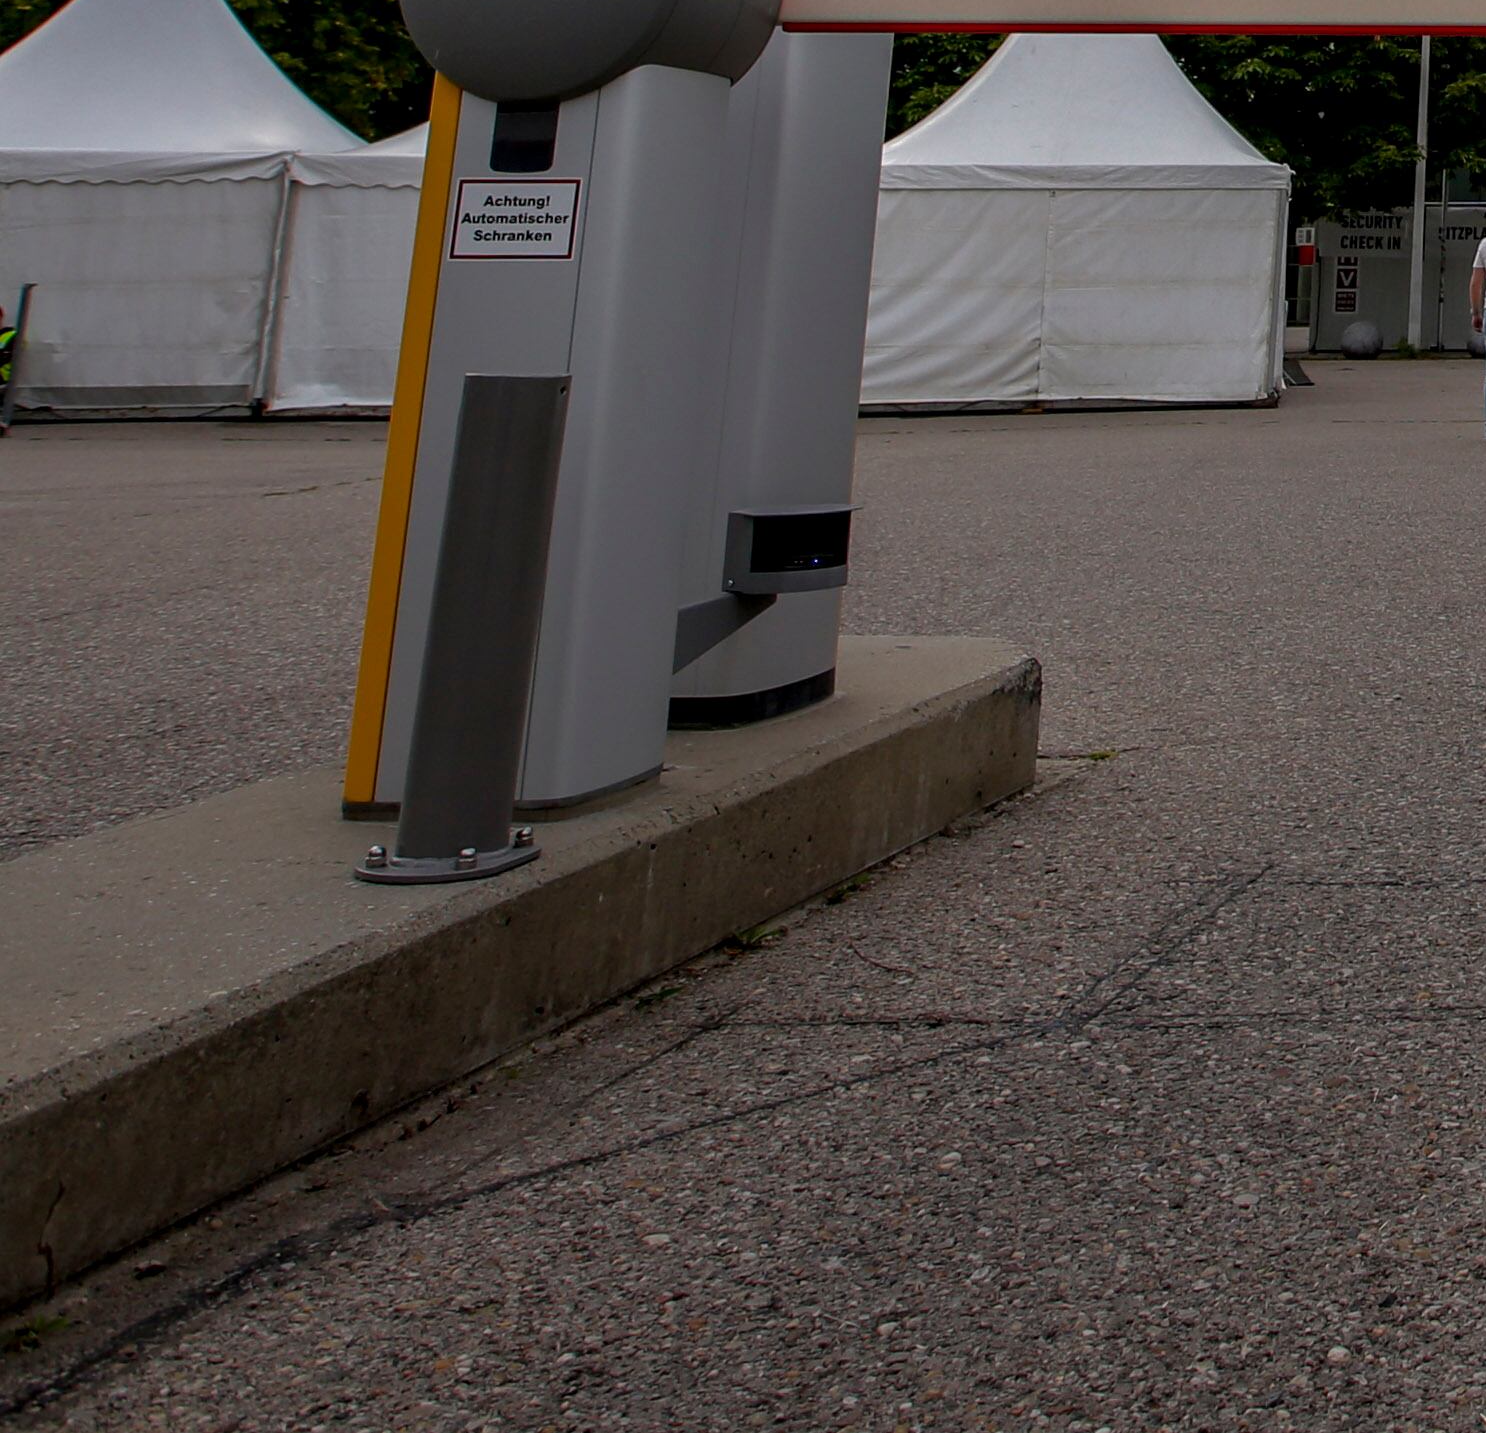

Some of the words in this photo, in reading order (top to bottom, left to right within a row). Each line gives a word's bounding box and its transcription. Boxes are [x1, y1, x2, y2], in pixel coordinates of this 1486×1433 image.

[483, 194, 551, 210] Achtung!
[461, 212, 570, 225] Automatischer
[1341, 215, 1403, 229] SECURITY
[473, 229, 553, 241] Schranken
[1340, 235, 1384, 250] CHECK
[1387, 236, 1401, 250] IN
